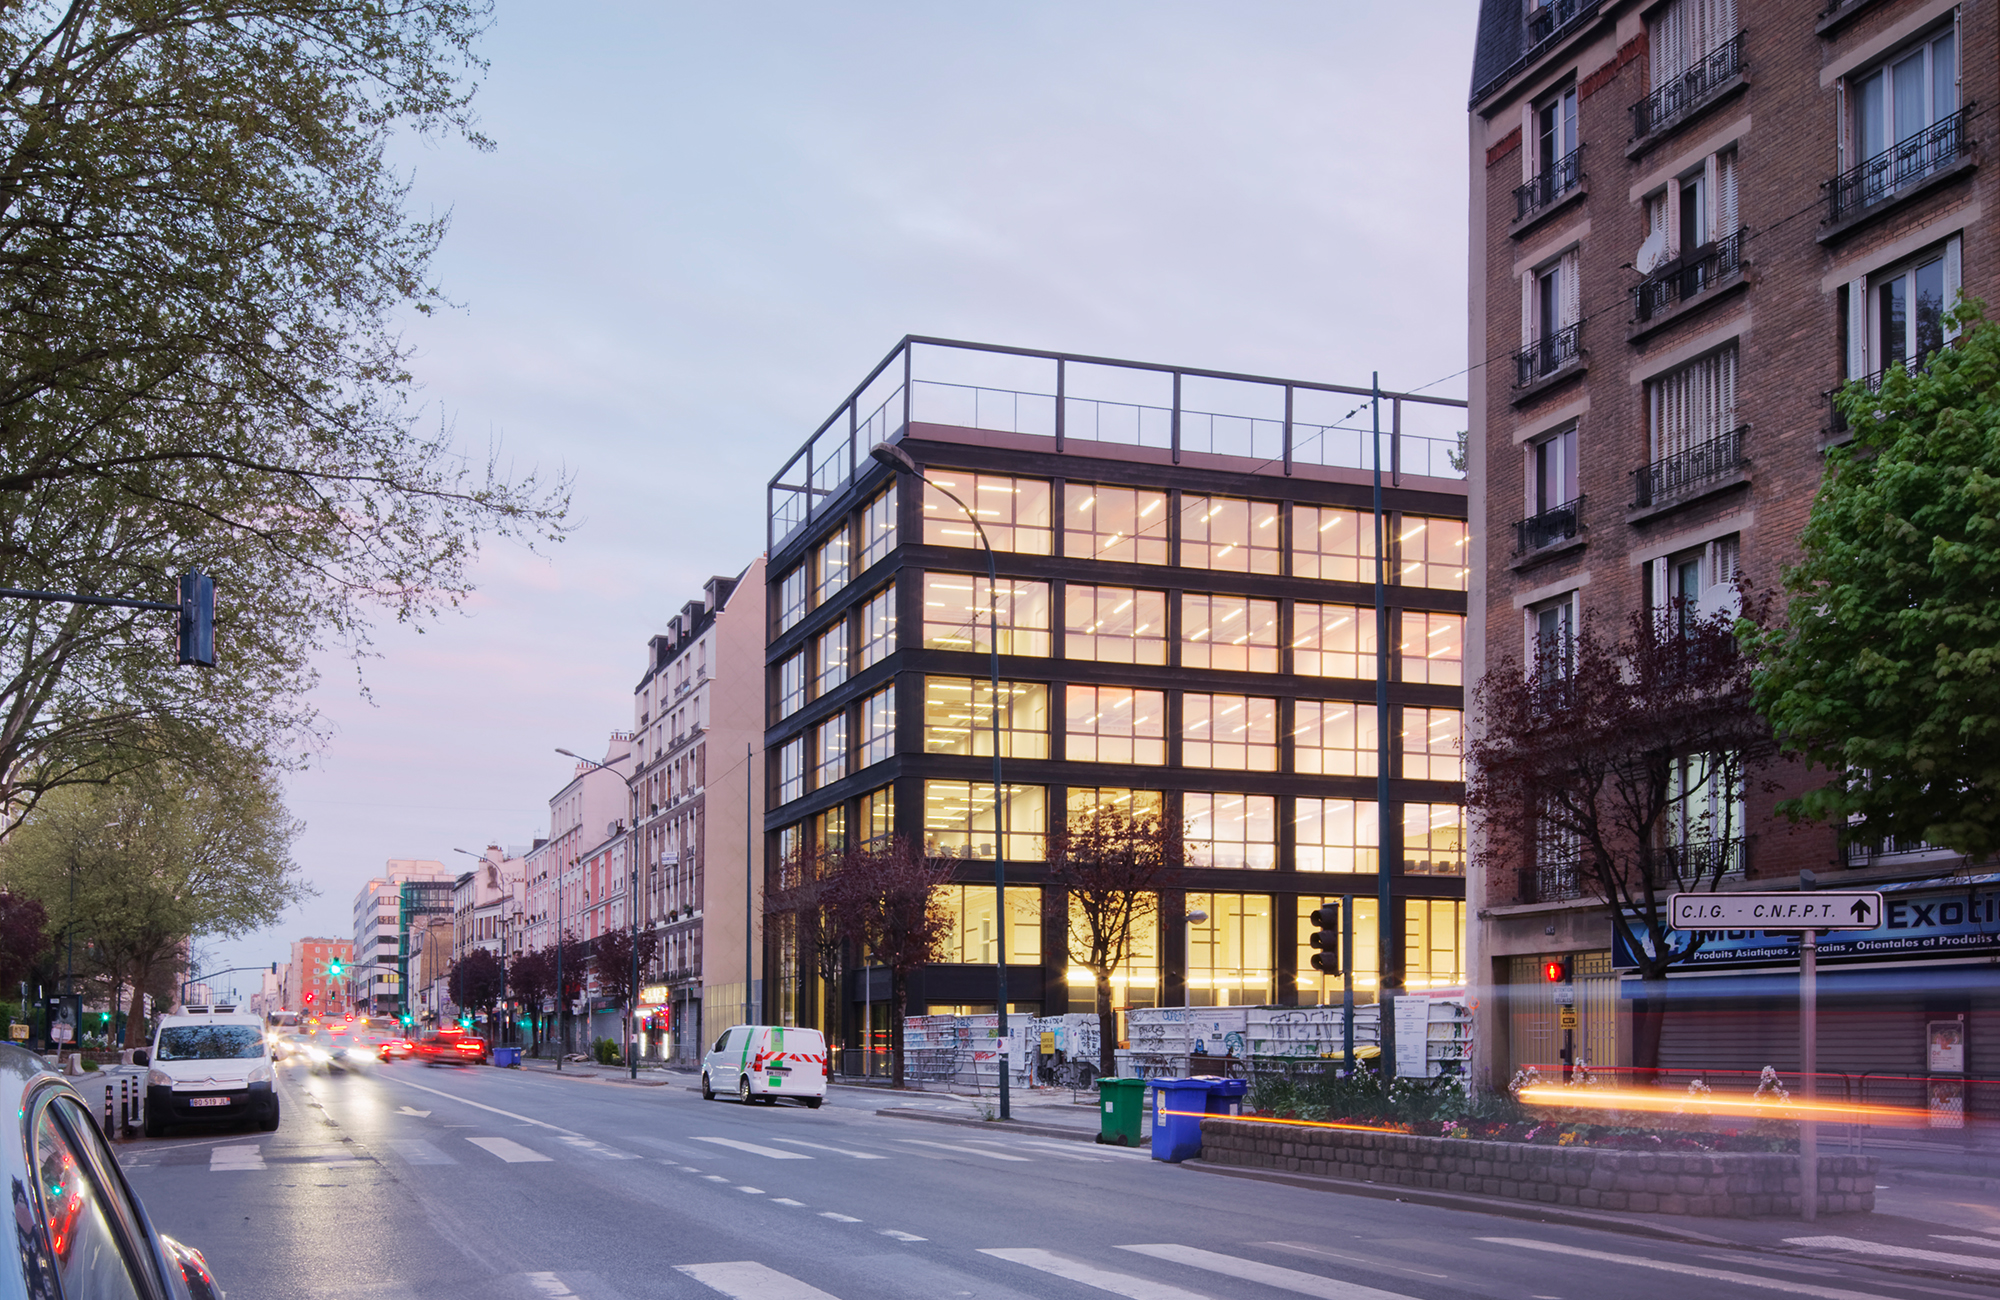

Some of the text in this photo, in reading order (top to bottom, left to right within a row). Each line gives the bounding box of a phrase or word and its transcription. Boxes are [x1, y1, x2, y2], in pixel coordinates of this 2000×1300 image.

[1681, 905, 1726, 918] C.I.G.
[1753, 904, 1835, 918] C.N.F.P.T.
[1887, 893, 2000, 929] Exoti
[1693, 950, 1733, 960] Produits
[1735, 948, 1789, 958] Asiatiques
[1856, 938, 1919, 950] Orientales
[1922, 937, 1935, 947] et
[1939, 934, 1992, 946] Produits
